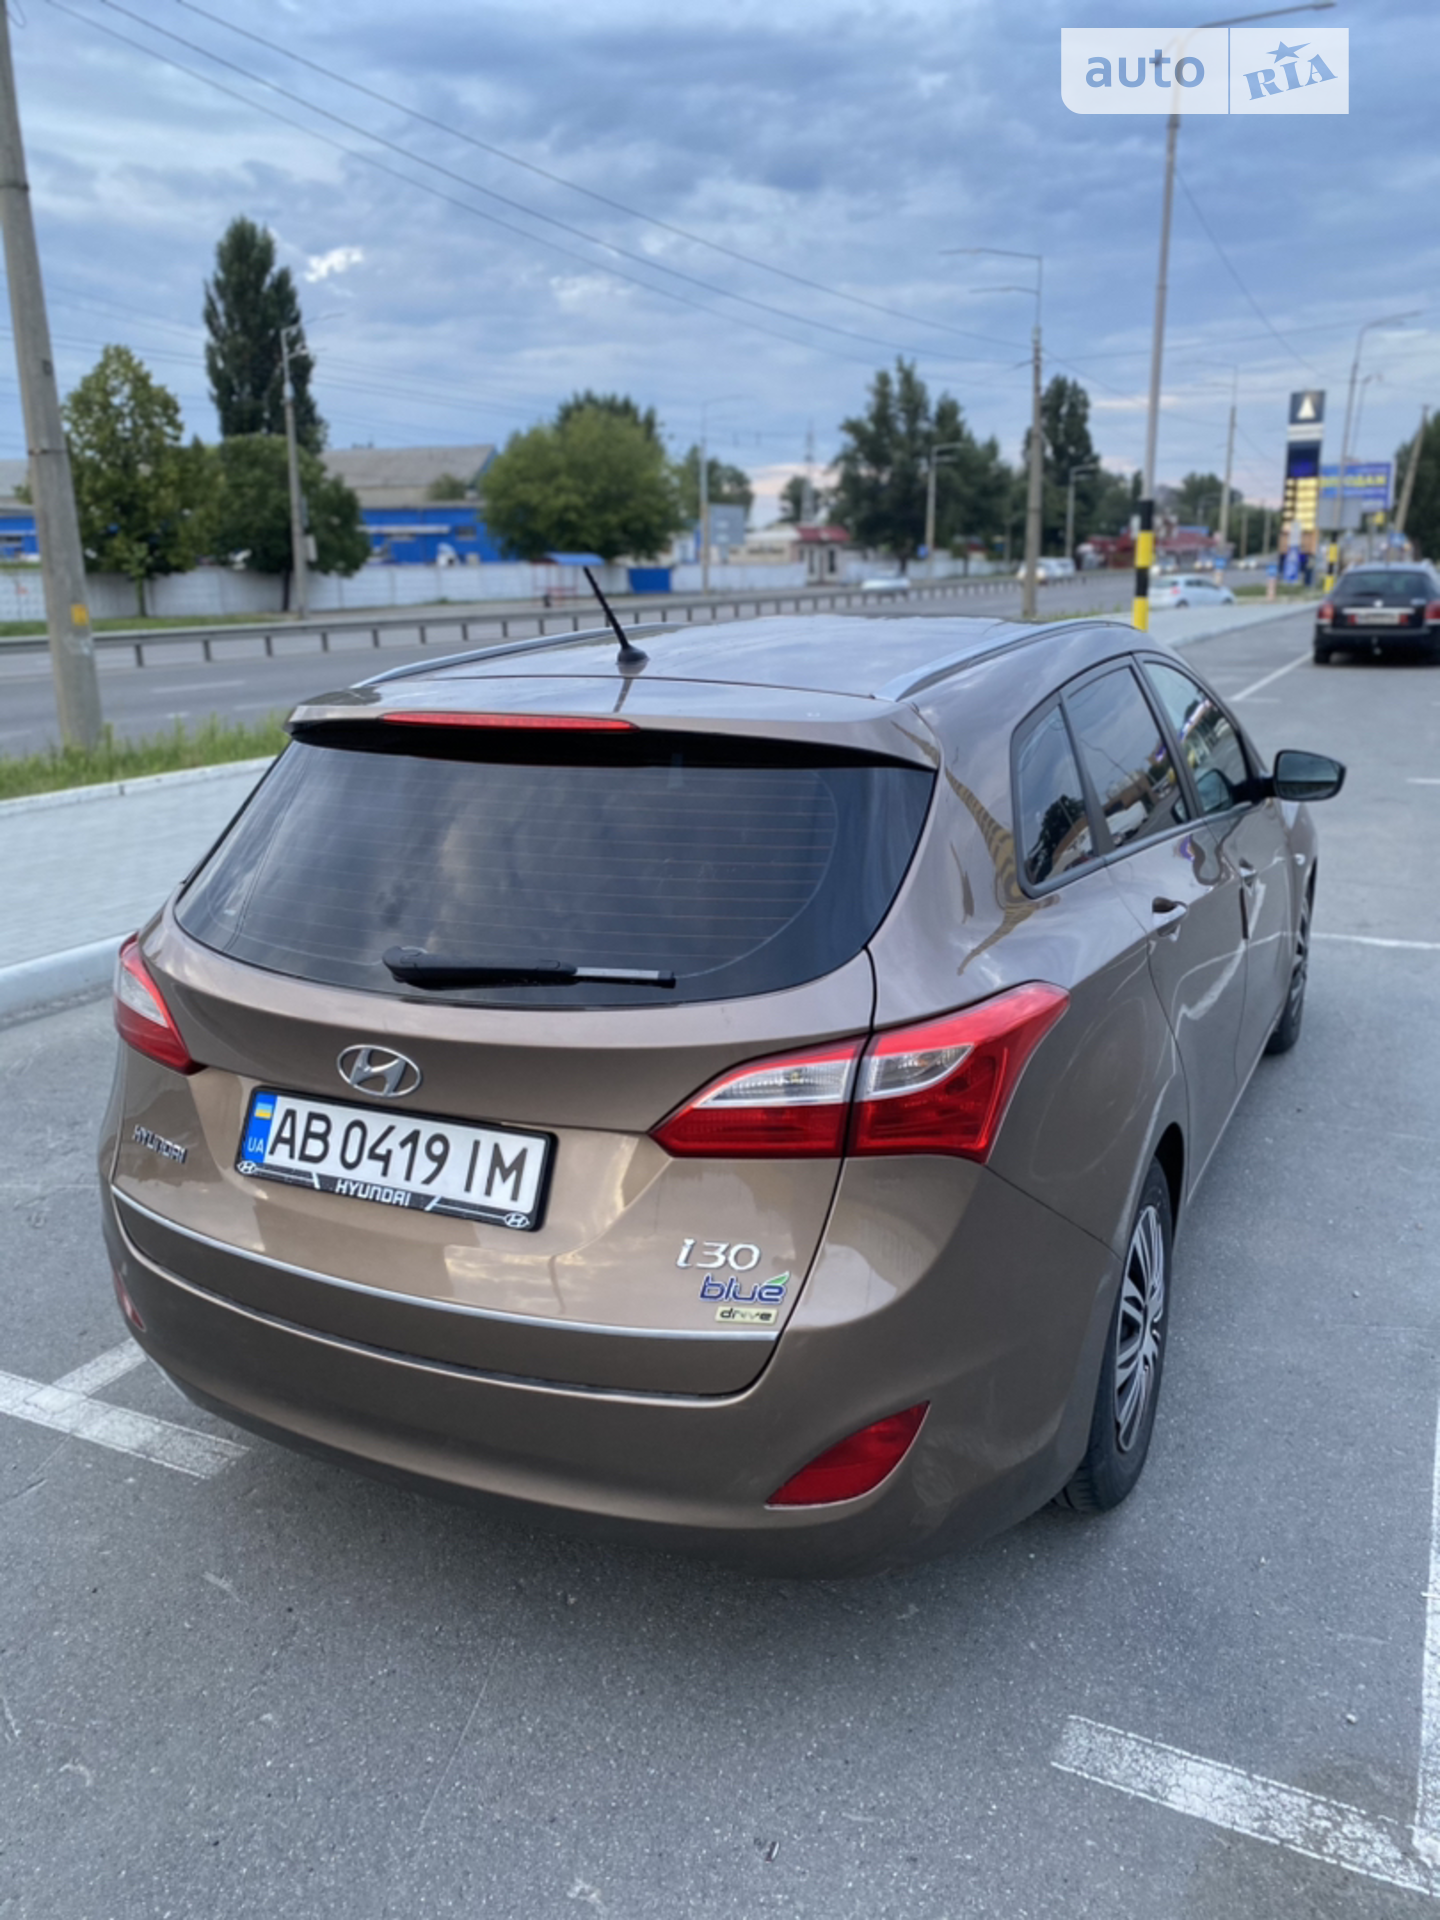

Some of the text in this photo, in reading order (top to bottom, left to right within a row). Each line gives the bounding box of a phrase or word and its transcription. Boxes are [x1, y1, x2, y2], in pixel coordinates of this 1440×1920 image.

[248, 1137, 265, 1155] UA
[268, 1108, 529, 1202] AB 0419 IM
[335, 1178, 411, 1207] HYUNDAI
[676, 1238, 761, 1271] i30
[699, 1272, 786, 1304] blue
[719, 1308, 773, 1321] drive
